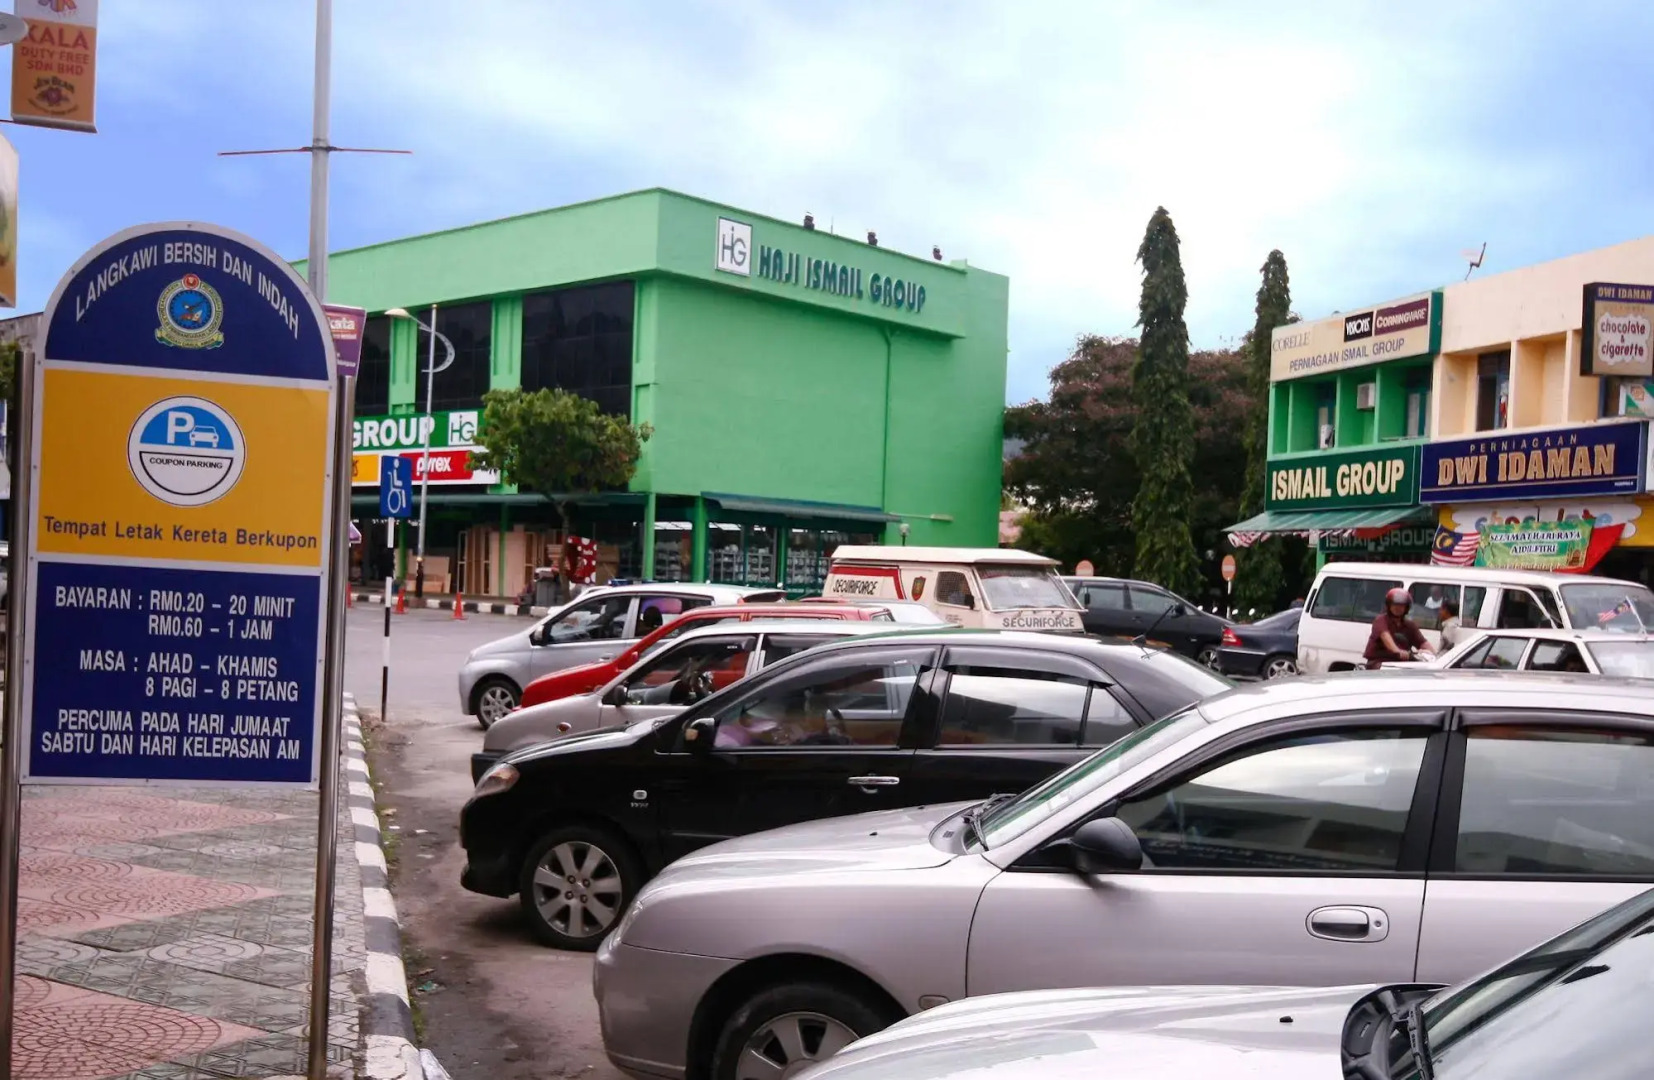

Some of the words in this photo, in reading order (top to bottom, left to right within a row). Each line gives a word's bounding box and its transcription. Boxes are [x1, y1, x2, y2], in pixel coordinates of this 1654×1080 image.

[21, 46, 54, 59] DUTY
[60, 51, 89, 64] FREE
[27, 60, 53, 71] SDN
[57, 64, 84, 76] BHD
[76, 245, 158, 323] LANGKAWI
[164, 242, 217, 267] BERSIH
[223, 252, 252, 286] DAN
[258, 272, 299, 339] INDAH
[758, 245, 800, 285] HAJI
[804, 257, 863, 299] ISMAIL
[869, 272, 926, 313] GROUP
[1598, 286, 1615, 299] DWI
[1618, 288, 1653, 300] IDAMAN
[1601, 319, 1645, 334] chocolate
[1272, 332, 1310, 352] CORELLE
[1289, 351, 1339, 372] PERNIAGAAN
[1341, 347, 1369, 362] ISMAIL
[1373, 338, 1405, 355] GROUP
[1601, 341, 1644, 358] cigarette
[167, 411, 195, 444] P
[1470, 434, 1578, 454] PERNIAGAAN
[149, 457, 185, 467] COUPON
[186, 460, 223, 469] PARKING
[1437, 455, 1488, 486] DWI
[1497, 444, 1616, 482] IDAMAN
[1271, 466, 1332, 501] ISMAIL
[1336, 459, 1405, 497] GROUP
[44, 516, 107, 539] Tempat
[115, 521, 163, 540] Letak
[172, 525, 227, 544] Kereta
[236, 528, 317, 552] Berkupon
[832, 579, 879, 596] SECURIFORCE
[55, 586, 131, 610] BAYARAN
[150, 590, 205, 613] RM0.20
[229, 595, 247, 616] 20
[254, 596, 296, 618] MINIT
[148, 615, 203, 638] RM0.60
[227, 619, 234, 639] 1
[240, 619, 273, 640] JAM
[1002, 617, 1075, 628] SECURIFORCE
[79, 649, 126, 672] MASA
[147, 652, 193, 674] AHAD
[217, 655, 278, 678] KHAMIS
[145, 676, 154, 697] 8
[162, 677, 197, 698] PAGI
[221, 679, 230, 700] 8
[236, 679, 299, 702] PETANG
[58, 708, 133, 731] PERCUMA
[141, 712, 180, 733] PADA
[188, 713, 224, 735] HARI
[230, 715, 290, 737] JUMAAT
[41, 731, 94, 754] SABTU
[101, 734, 133, 755] DAN
[139, 735, 176, 756] HARI
[183, 736, 271, 759] KELEPASAN
[276, 739, 300, 760] AM
